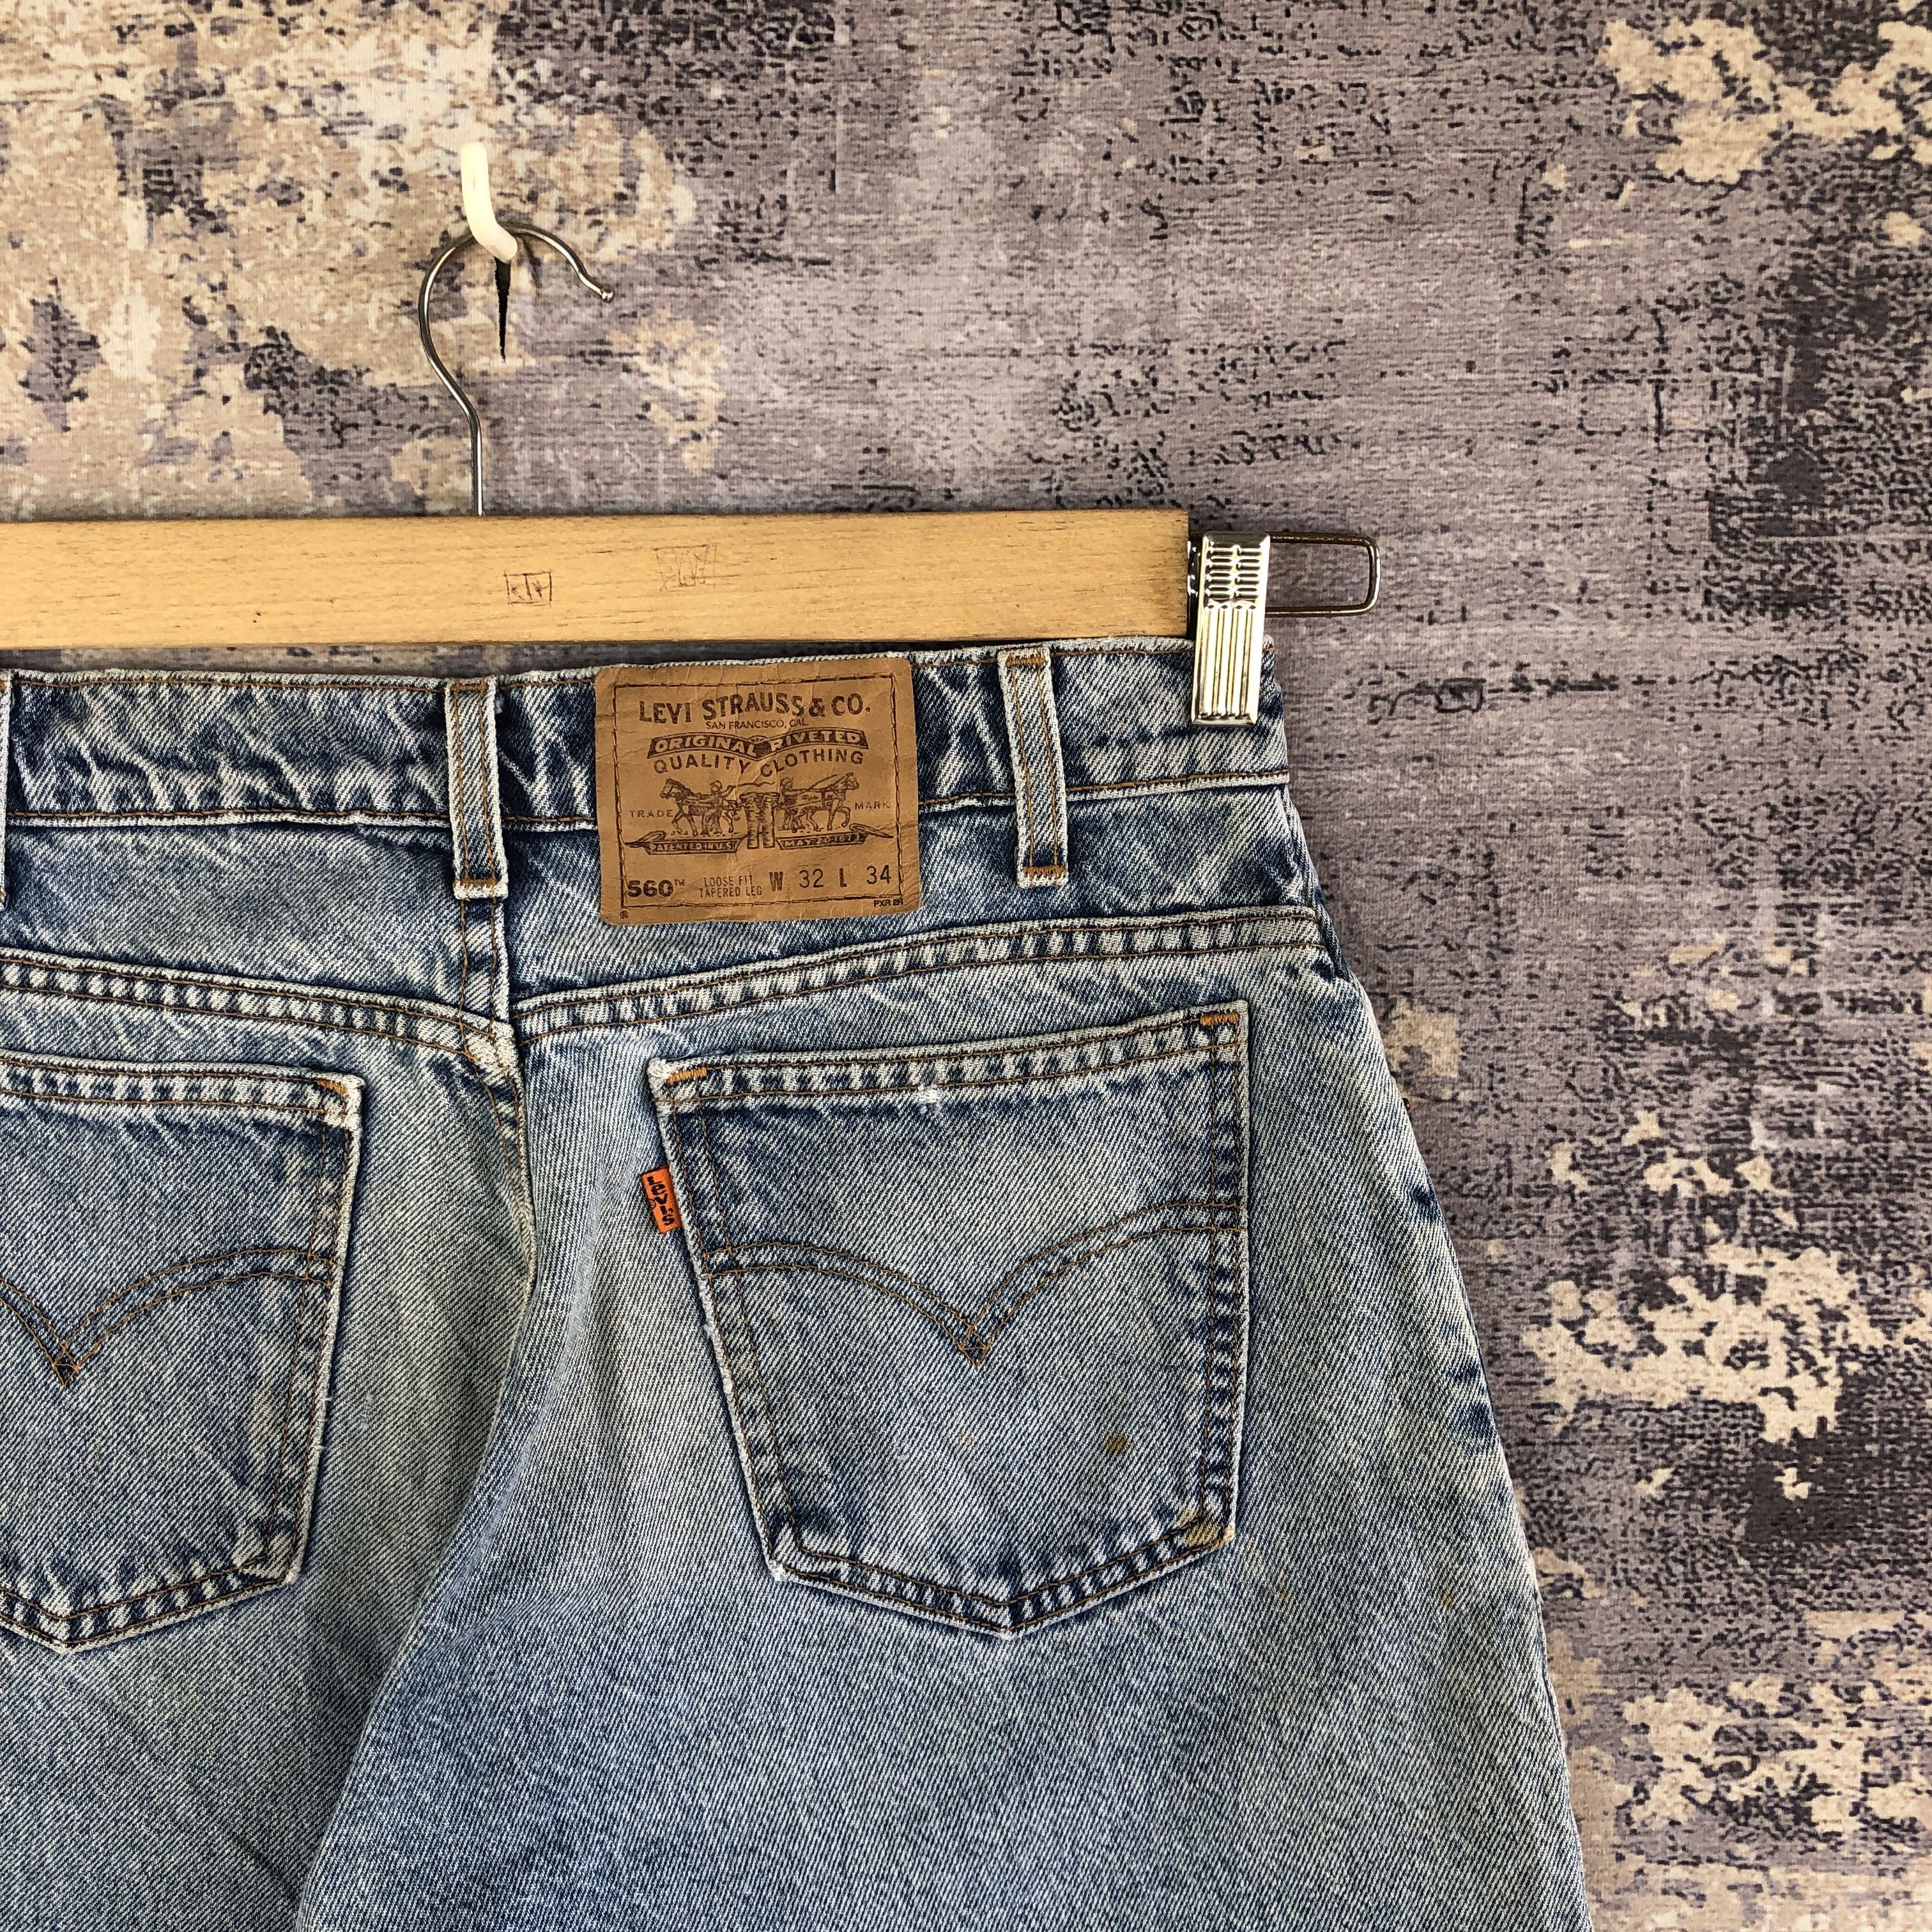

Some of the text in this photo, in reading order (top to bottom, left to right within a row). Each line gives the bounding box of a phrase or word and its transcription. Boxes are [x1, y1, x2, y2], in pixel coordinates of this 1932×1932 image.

[639, 701, 691, 724] LEVI
[831, 693, 870, 716] CO.
[706, 721, 726, 730] SAN
[729, 719, 786, 730] FRANCISCO,
[656, 731, 861, 757] ORIGINAL RIVETED
[654, 748, 864, 778] QUALITY CLOTHING
[855, 801, 891, 809] MARK
[629, 809, 673, 818] TRADE
[704, 875, 753, 887] LOOSE FIT
[769, 864, 891, 891] W 32 L 34
[699, 885, 762, 898] TAPERED LEG
